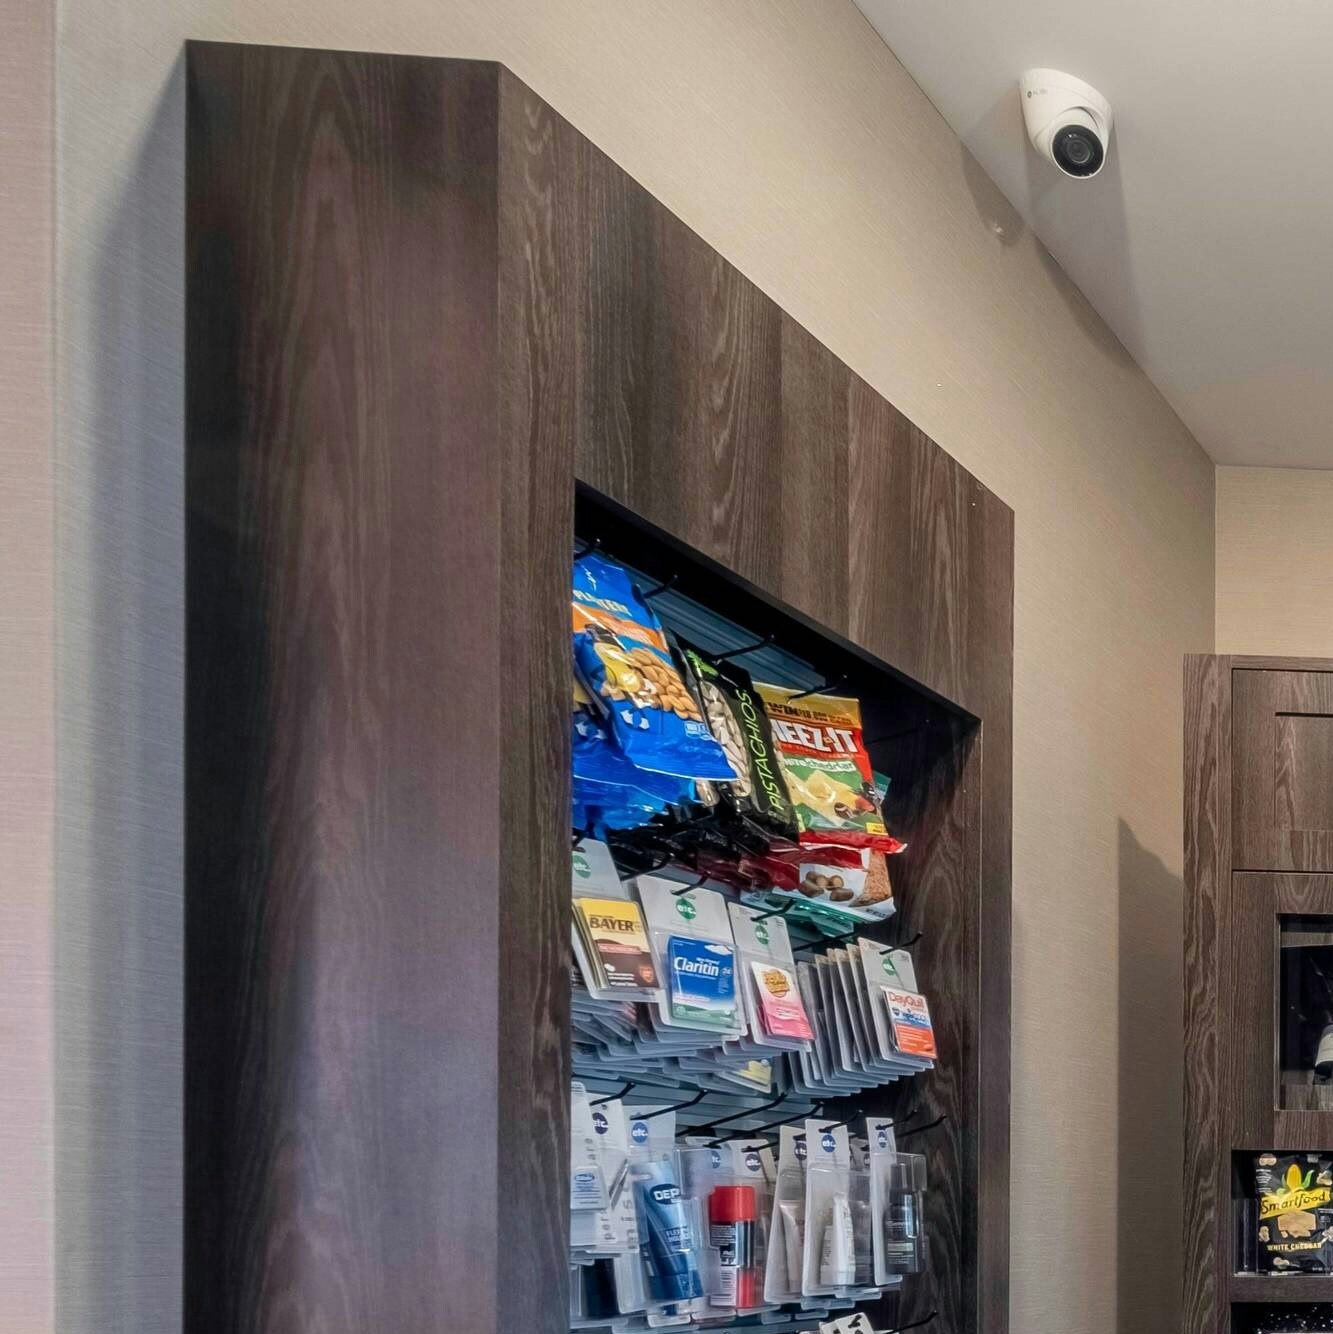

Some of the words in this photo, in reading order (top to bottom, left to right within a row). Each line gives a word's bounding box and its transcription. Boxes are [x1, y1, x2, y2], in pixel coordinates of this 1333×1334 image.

[735, 689, 785, 811] PISTACHIOS
[589, 916, 635, 932] BAYER
[673, 956, 719, 977] Claritin
[1261, 1190, 1326, 1214] Smartfood
[1267, 1243, 1289, 1251] WHITE
